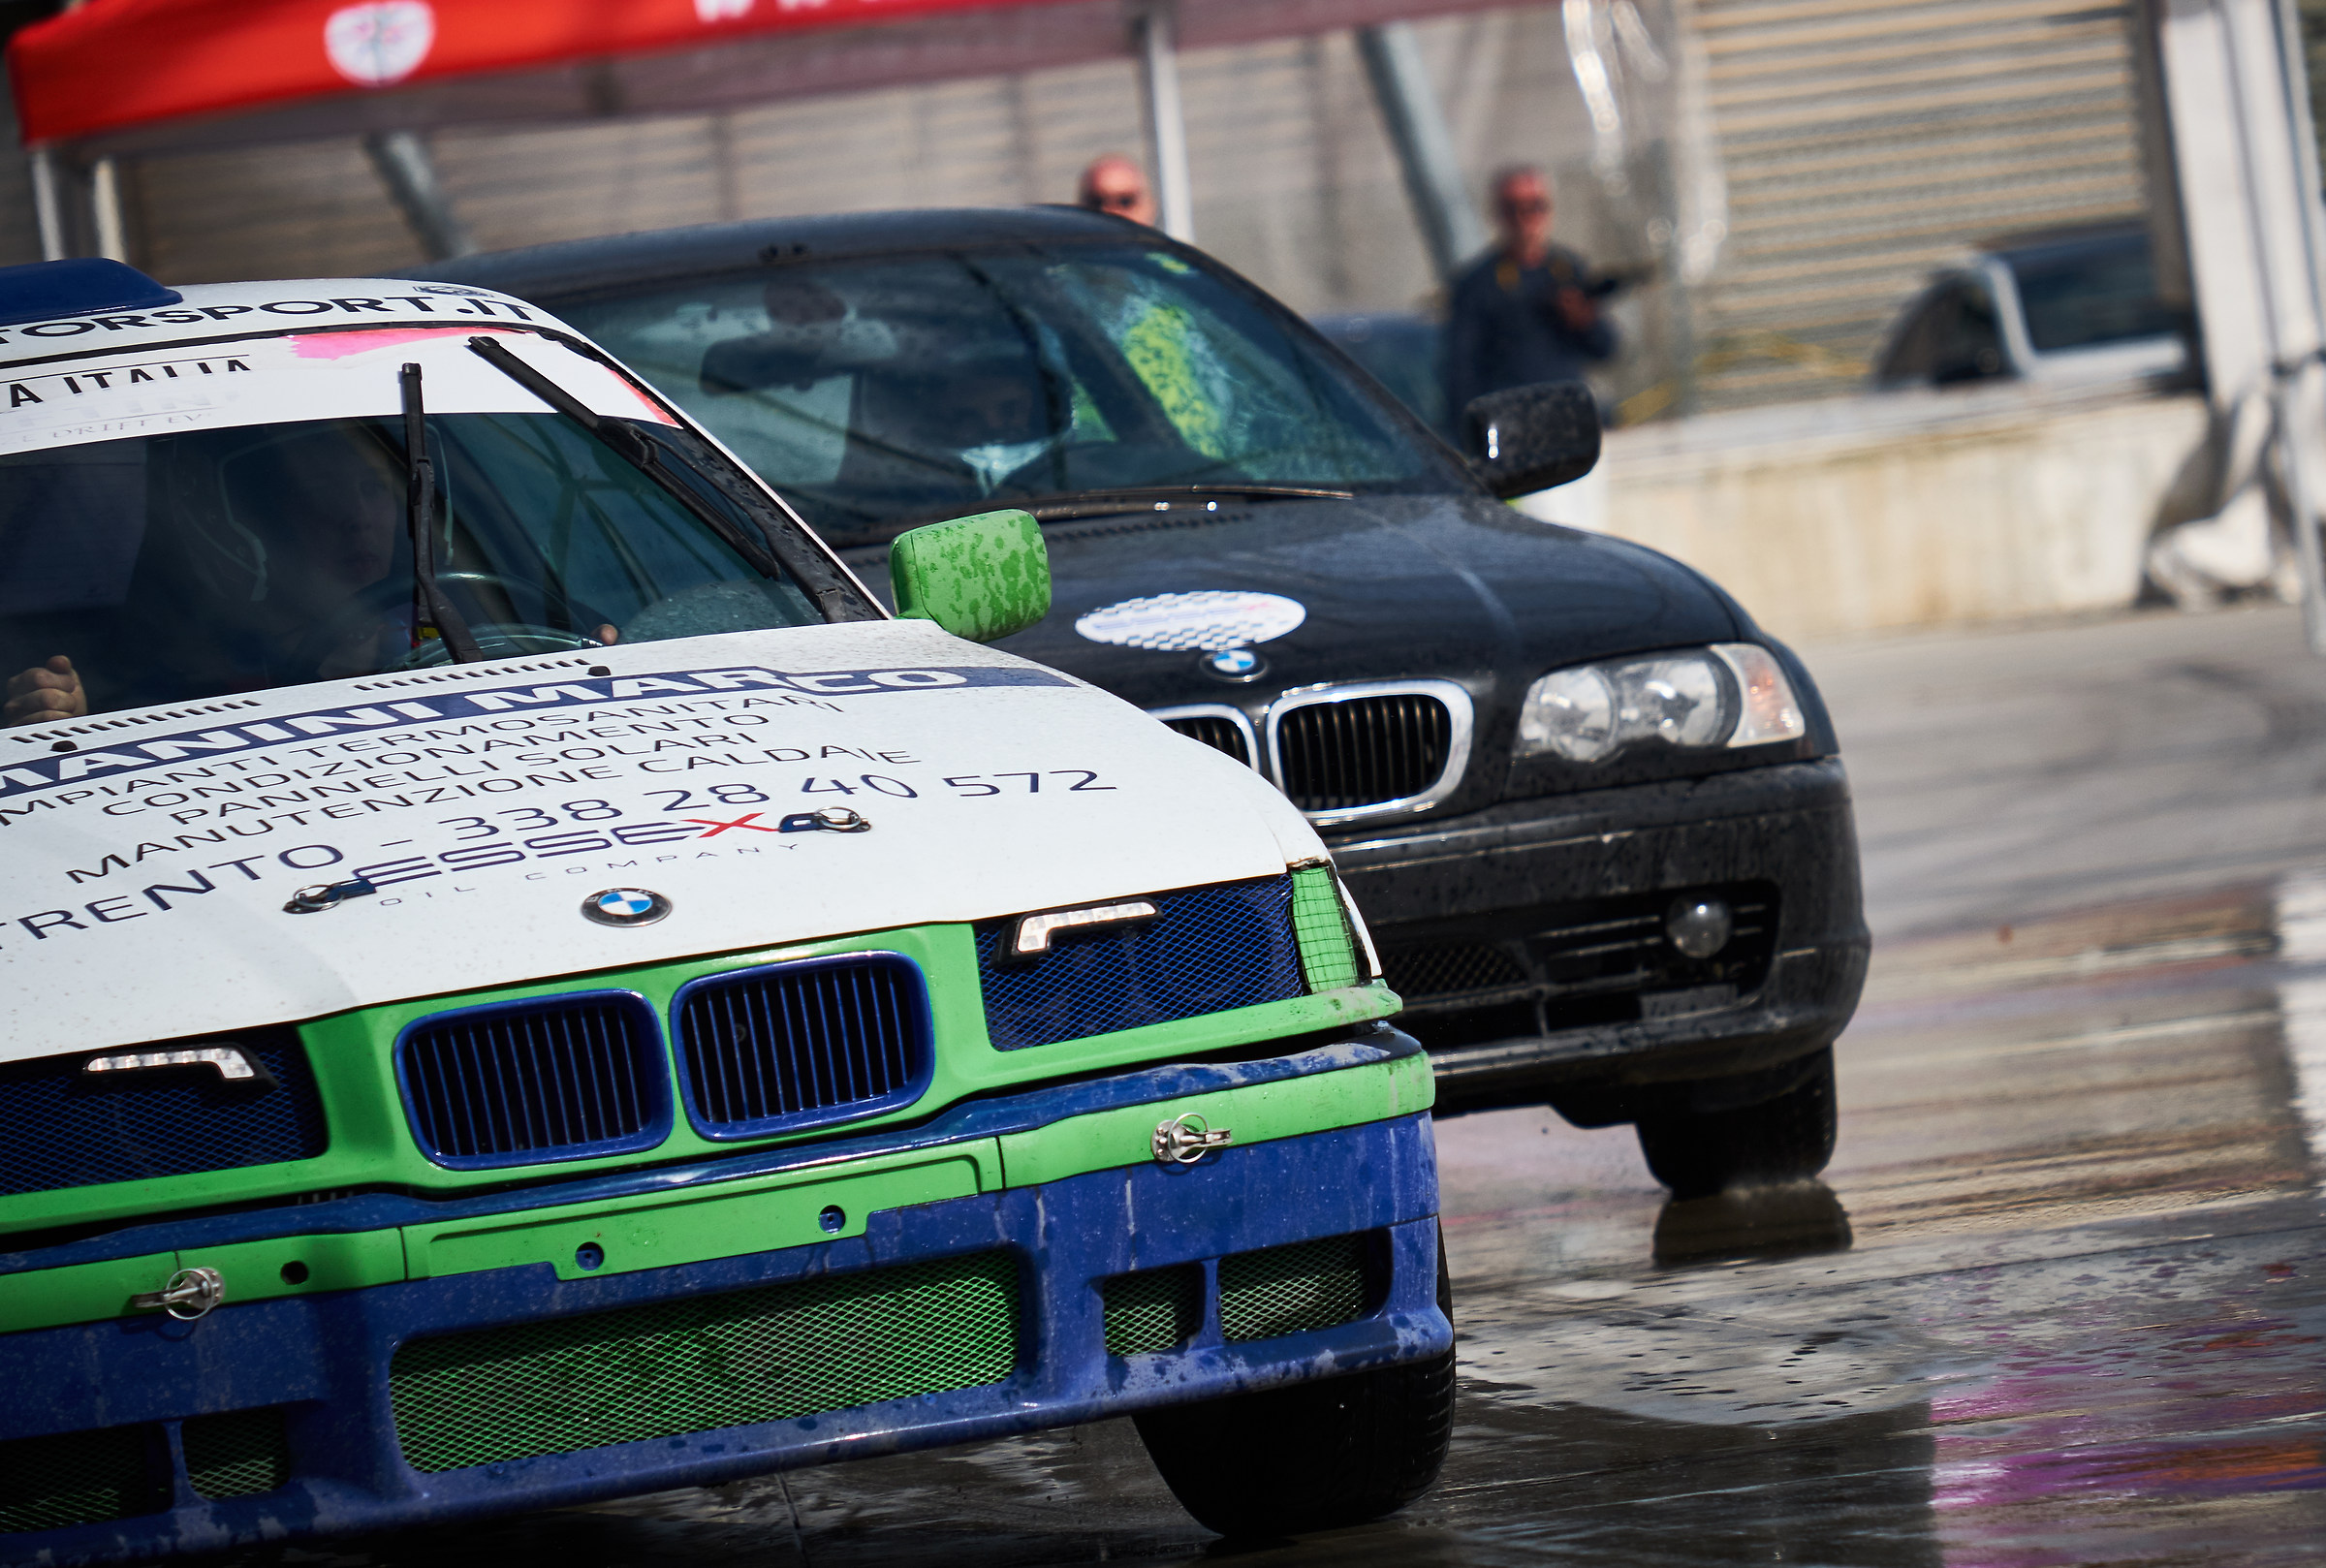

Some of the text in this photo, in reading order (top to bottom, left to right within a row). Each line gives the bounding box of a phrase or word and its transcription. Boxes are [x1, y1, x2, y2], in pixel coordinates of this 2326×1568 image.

[289, 694, 845, 759] TERMOSANITARI
[464, 667, 967, 710] MARCO
[102, 713, 770, 817] CONDIZIONAMENTO
[171, 733, 758, 826] PANNELLI SOLARI
[66, 744, 923, 885] MANUTENZIONE CALDAIE
[352, 811, 780, 887] ESSEX
[0, 844, 344, 951] RENTO
[438, 799, 622, 841] 338
[644, 783, 770, 812] 28
[801, 773, 919, 799] 40
[942, 769, 1117, 798] 572
[379, 843, 800, 907] OIL COMPANY
